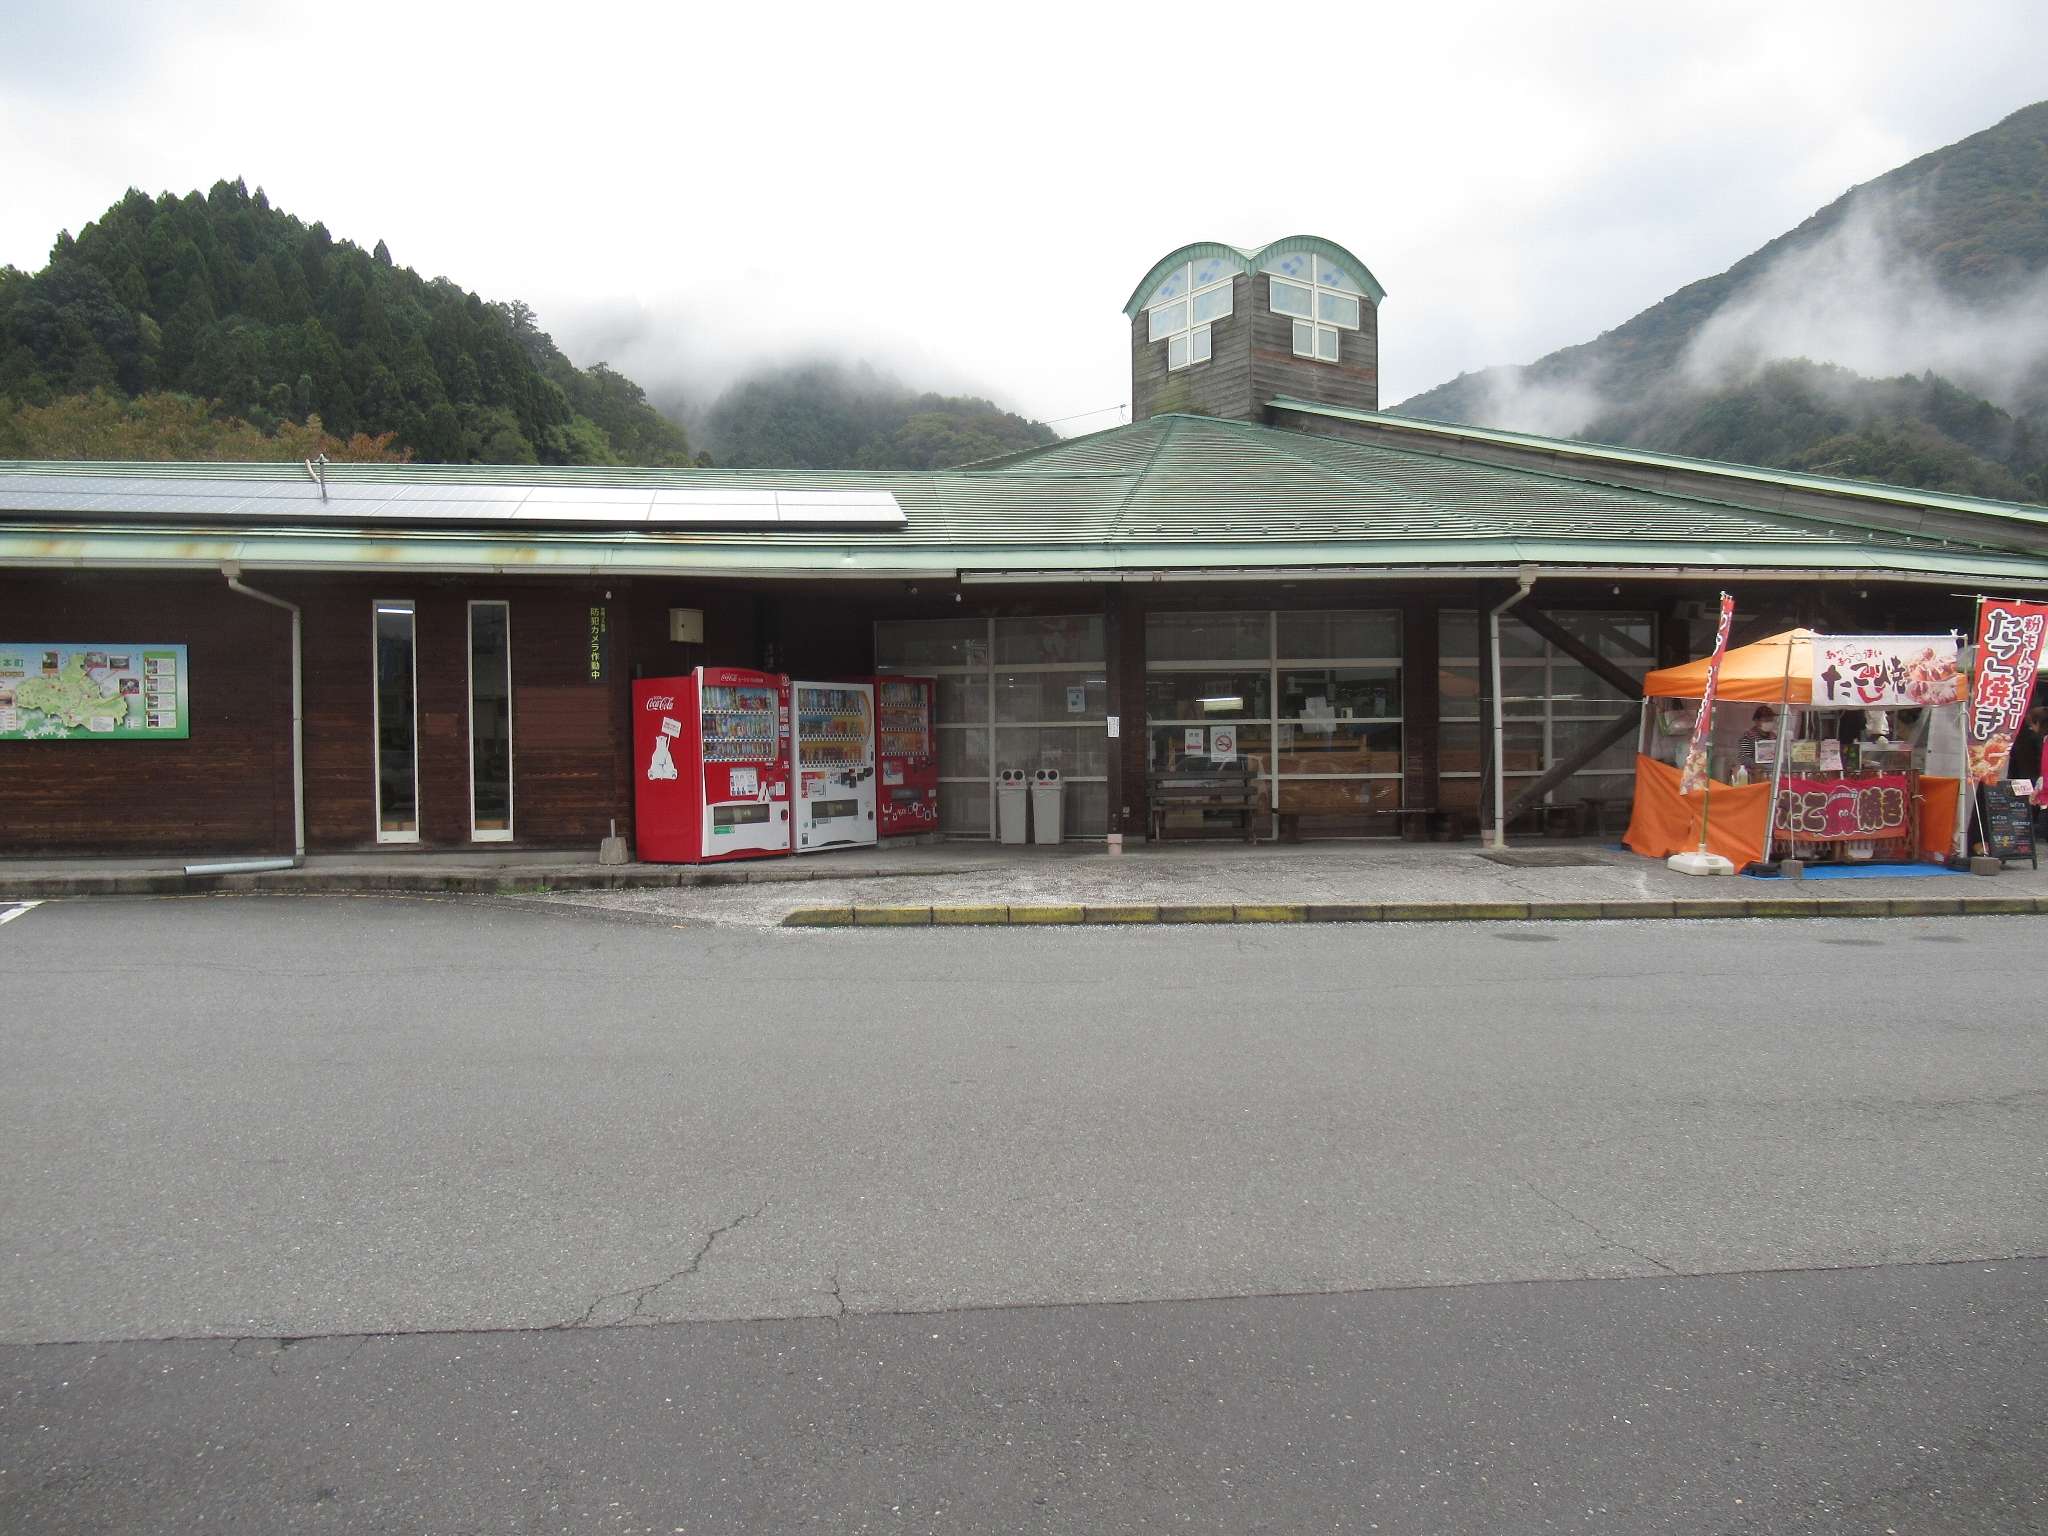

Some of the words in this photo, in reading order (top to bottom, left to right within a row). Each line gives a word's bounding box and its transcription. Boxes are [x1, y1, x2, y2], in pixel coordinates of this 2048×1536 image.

[590, 607, 600, 680] 防犯カメラ作動中
[646, 695, 675, 711] Coca-Cola
